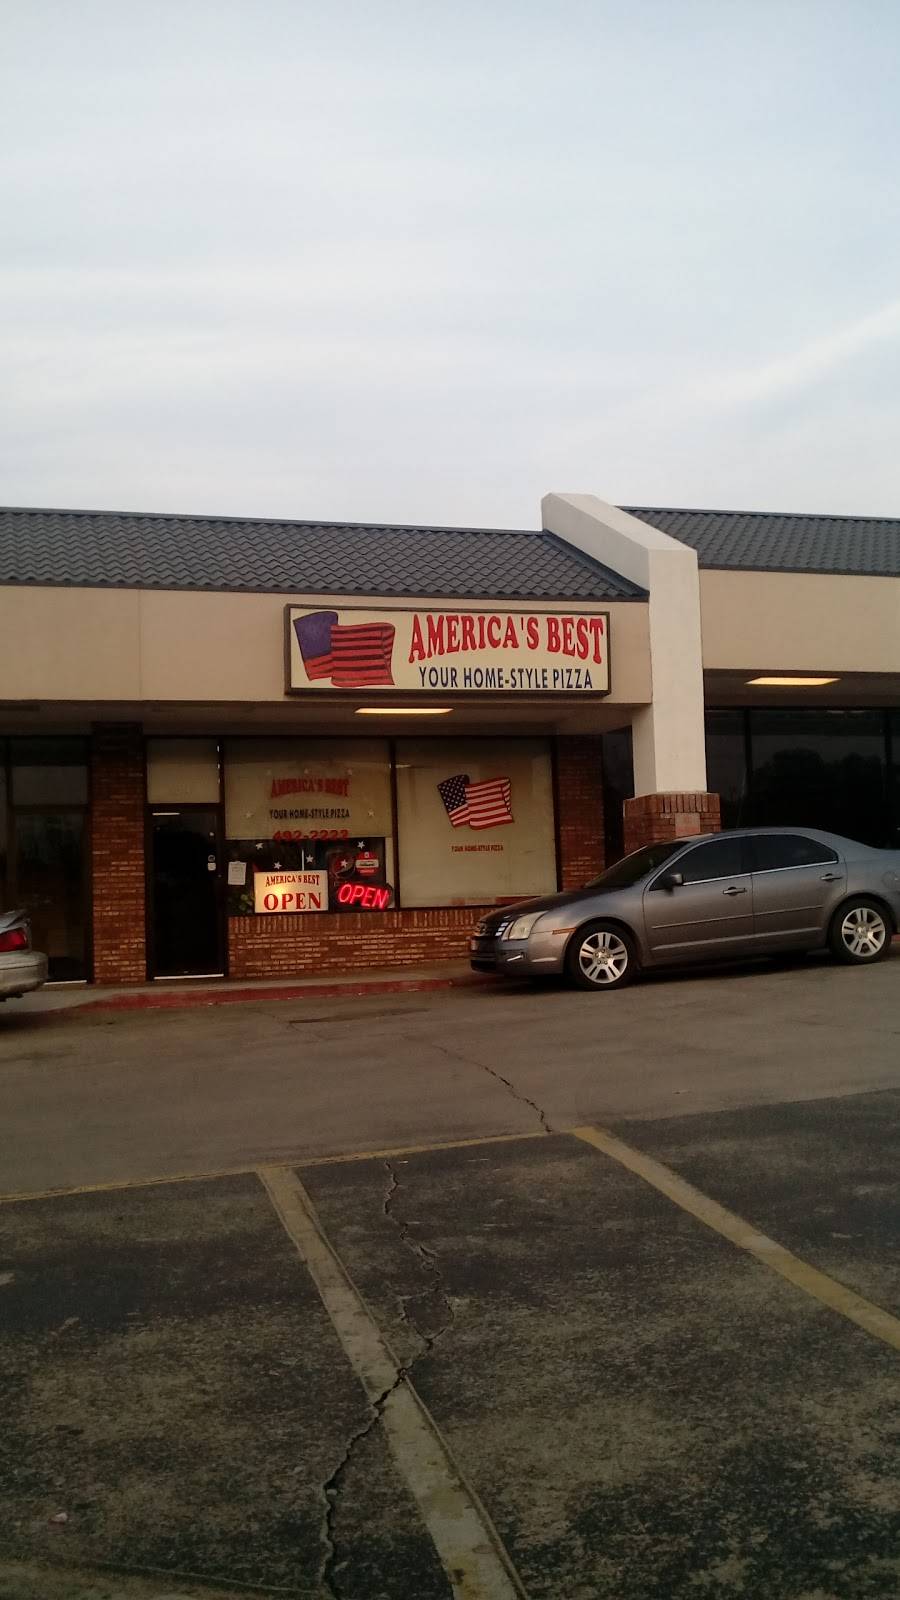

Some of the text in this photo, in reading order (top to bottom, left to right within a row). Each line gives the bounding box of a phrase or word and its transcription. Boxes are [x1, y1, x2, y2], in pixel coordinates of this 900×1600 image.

[408, 613, 604, 664] AMERICA'S BEST
[418, 666, 593, 690] YOUR HOME-STYLE PIZZA
[269, 808, 288, 820] YOUR
[330, 808, 350, 818] PIZZA
[265, 875, 320, 887] AMERICA'S BEST
[263, 892, 321, 911] OPEN
[337, 883, 389, 910] OPEN
